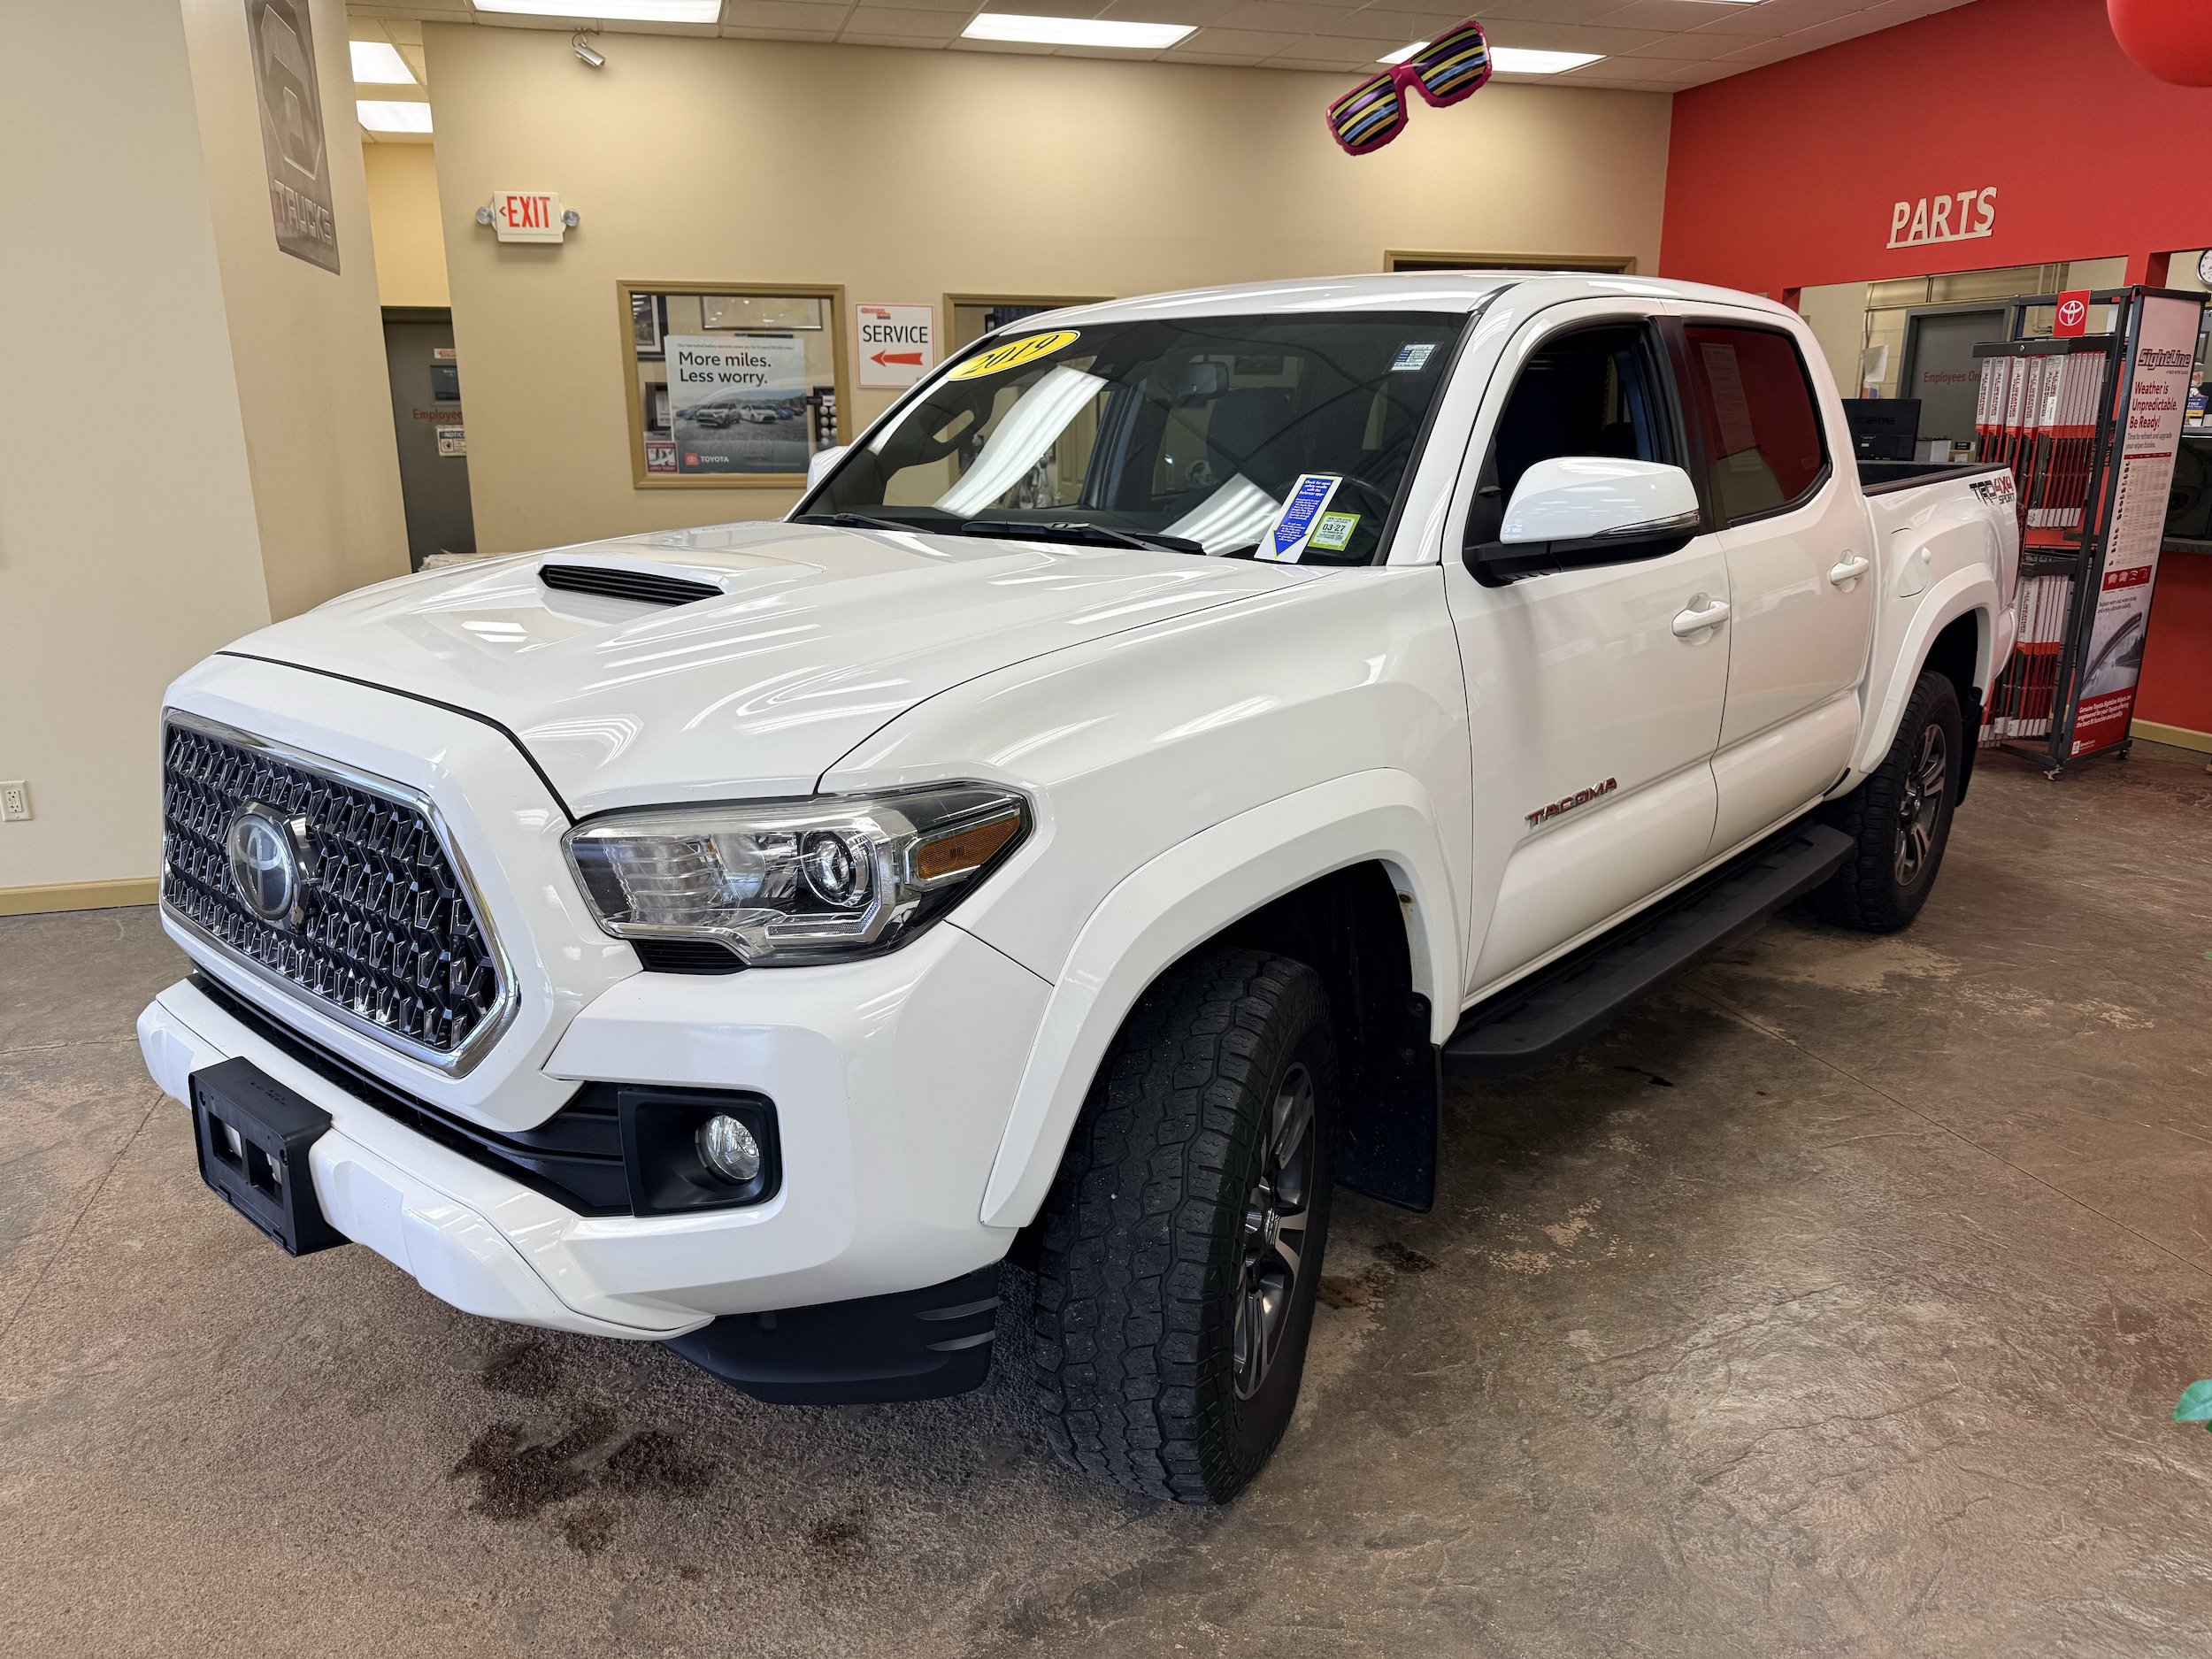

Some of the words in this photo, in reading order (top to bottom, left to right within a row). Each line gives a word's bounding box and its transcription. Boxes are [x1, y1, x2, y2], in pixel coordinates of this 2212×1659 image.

[273, 180, 333, 247] TRUCKS
[506, 196, 550, 228] EXIT
[1886, 186, 1998, 249] PARTS
[863, 325, 928, 343] SERVICE
[679, 351, 720, 365] More
[726, 352, 772, 367] miles.
[959, 334, 1060, 377] 2019
[2138, 349, 2192, 370] SightLine
[680, 368, 714, 382] Less
[718, 371, 768, 387] worry.
[1924, 372, 1965, 386] Employees
[2012, 373, 2021, 417] ALL-WEATHER
[2134, 380, 2163, 395] Weather
[2164, 381, 2169, 394] is
[2132, 396, 2177, 414] Unpredictable.
[412, 409, 462, 422] Employee
[2129, 416, 2138, 428] Be
[2139, 415, 2160, 431] Ready!
[1969, 480, 1997, 507] TRD
[1998, 493, 2015, 505] SPORT
[1524, 775, 1617, 828] TACOMA
